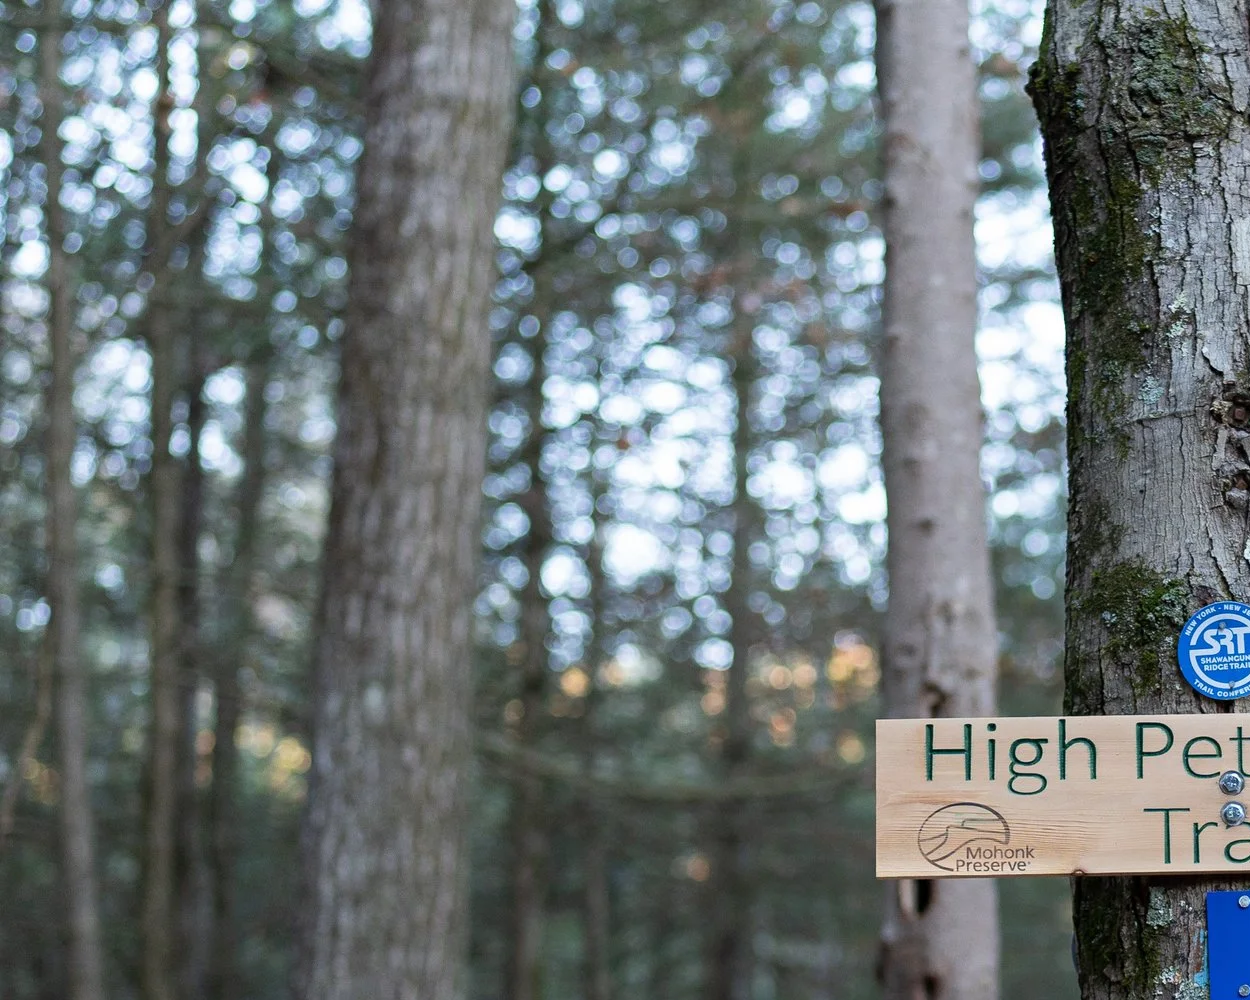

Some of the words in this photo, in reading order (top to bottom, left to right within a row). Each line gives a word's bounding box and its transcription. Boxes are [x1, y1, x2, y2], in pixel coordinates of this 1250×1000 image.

[1185, 620, 1198, 636] NEW
[1196, 606, 1217, 620] YORK
[1203, 626, 1250, 655] SRT
[1204, 662, 1229, 672] RIDGE
[1194, 678, 1215, 695] TRAIL
[925, 718, 1097, 796] High
[966, 845, 1035, 859] Mohonk
